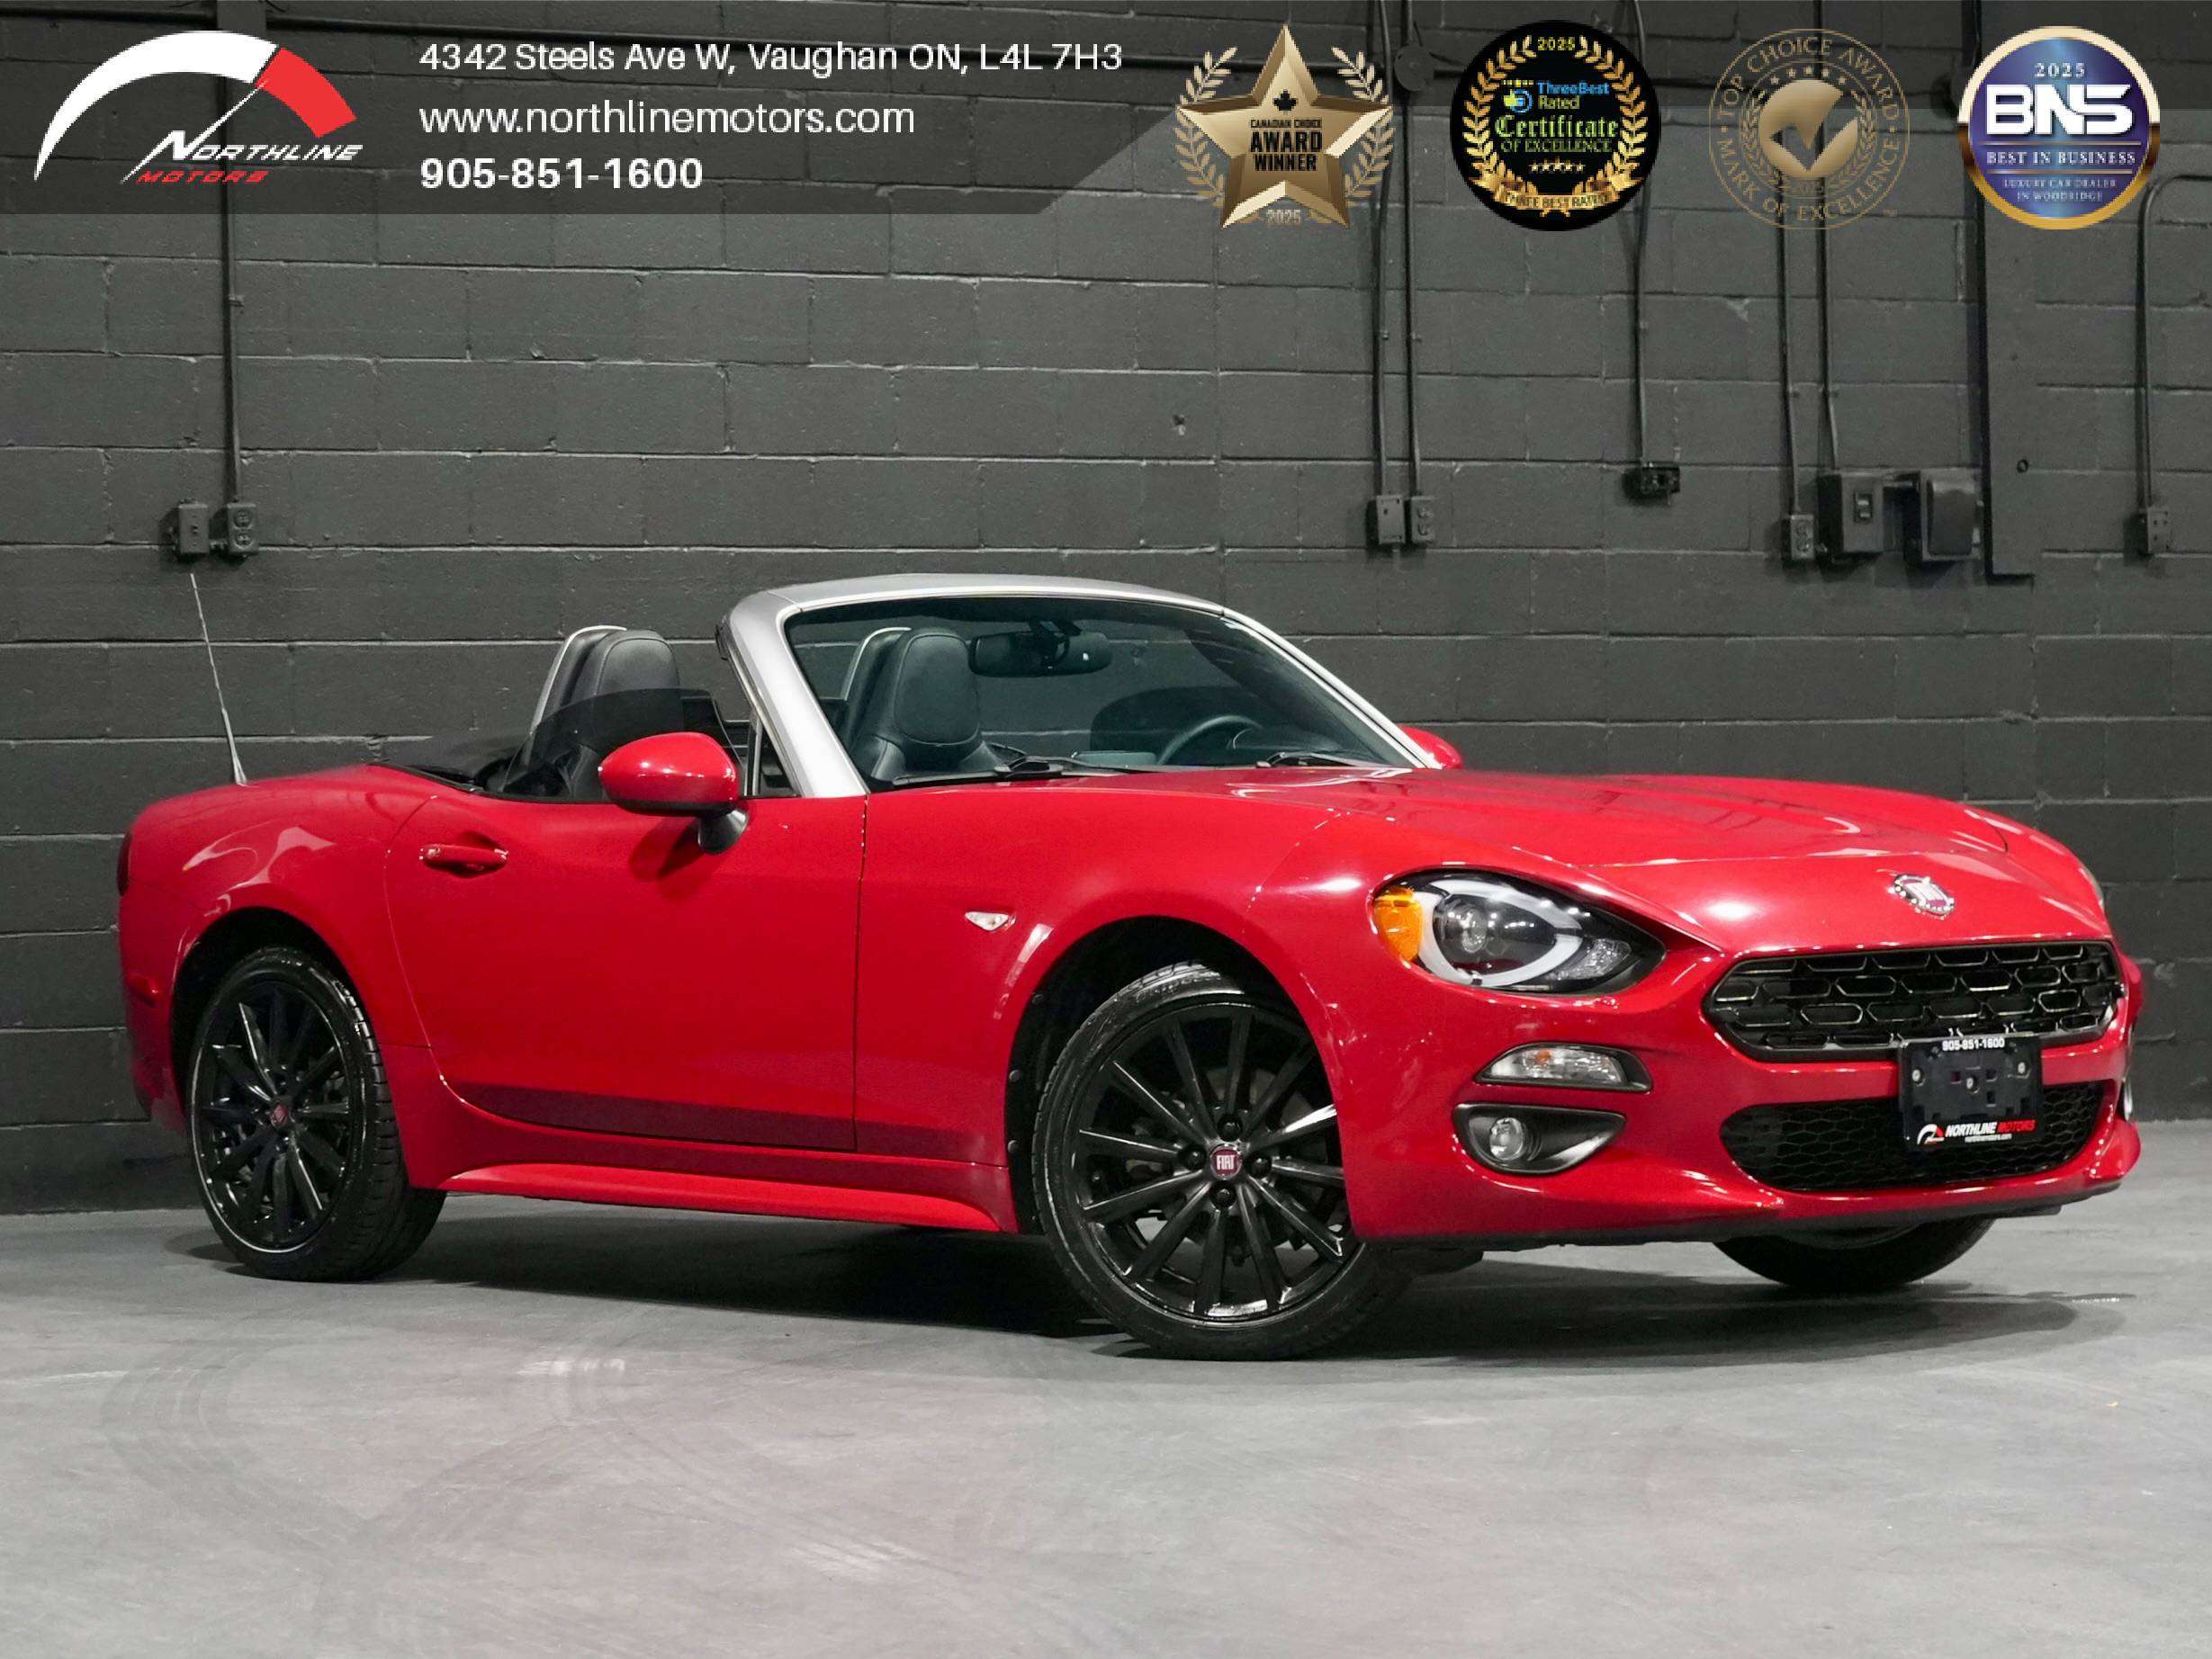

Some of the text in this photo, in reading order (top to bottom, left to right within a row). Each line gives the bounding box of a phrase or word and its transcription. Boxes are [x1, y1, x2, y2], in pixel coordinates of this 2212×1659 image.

[1942, 1037, 2005, 1052] 905-851-1600
[1945, 1121, 1998, 1137] NORTHLINE
[1217, 1154, 1235, 1170] FIAT
